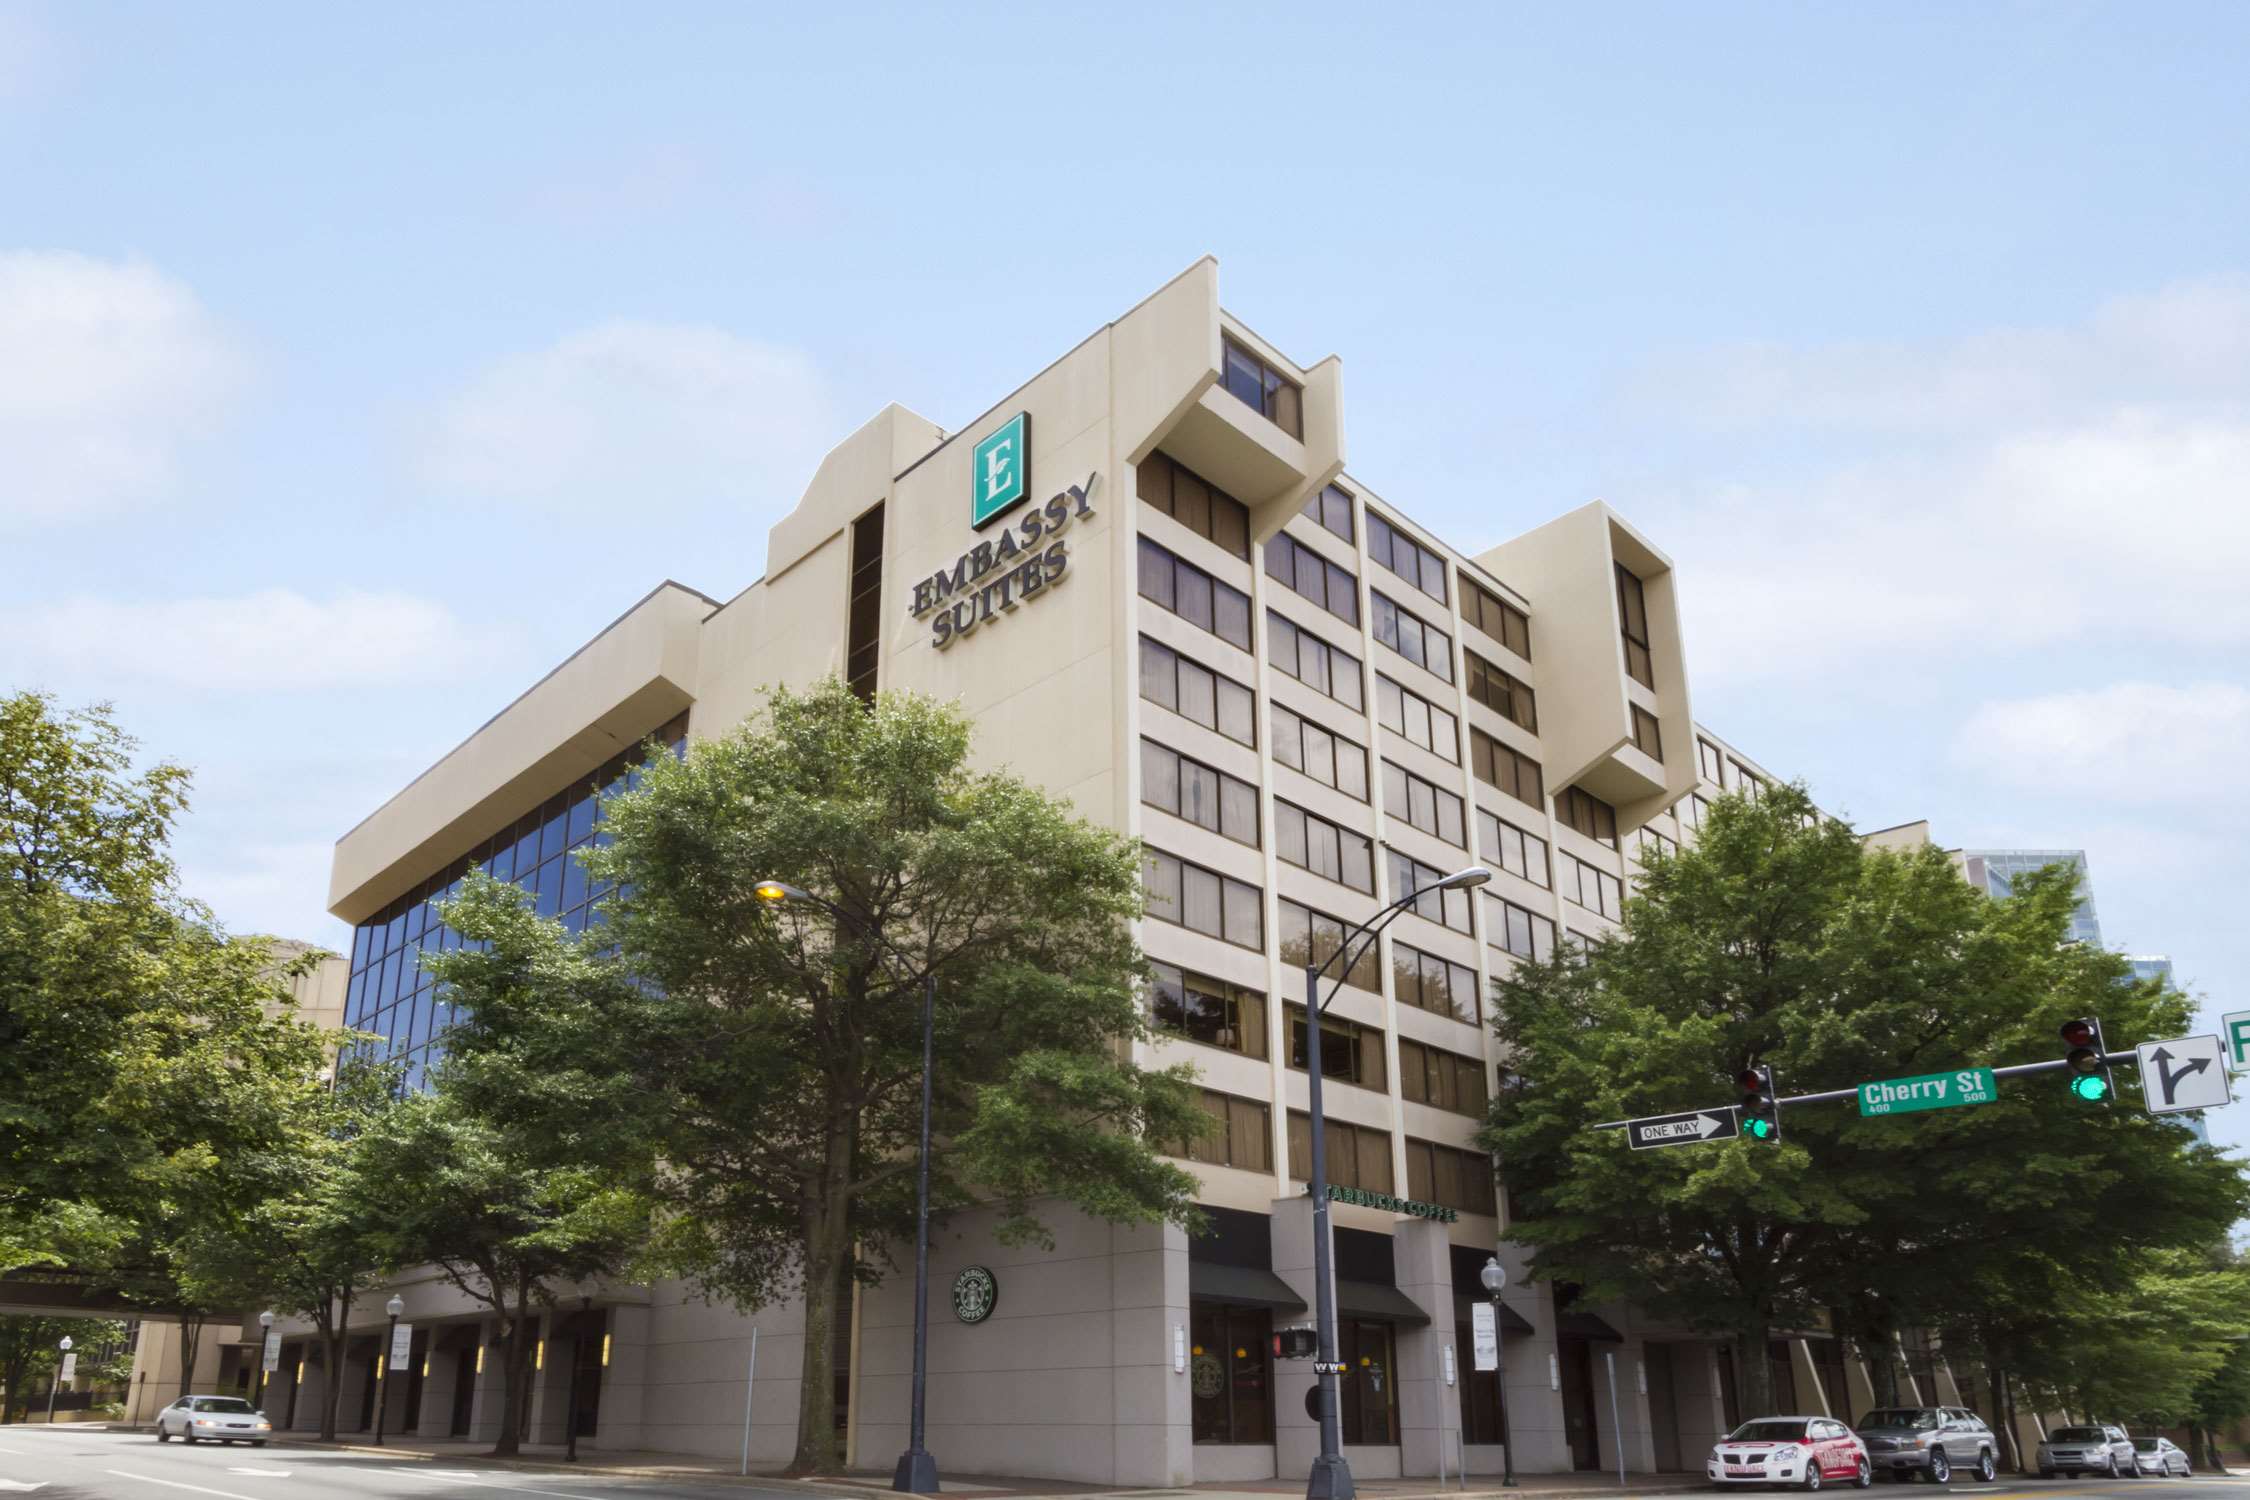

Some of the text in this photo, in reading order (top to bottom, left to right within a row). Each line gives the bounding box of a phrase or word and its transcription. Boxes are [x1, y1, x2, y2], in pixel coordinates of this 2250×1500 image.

[984, 438, 1012, 501] E
[911, 470, 1098, 619] EMBASSY
[932, 540, 1069, 650] SUITES
[1864, 1071, 1985, 1105] Cherry St
[1869, 1091, 1987, 1113] 400 500
[1643, 1121, 1700, 1139] ONE WAY
[1407, 1200, 1459, 1223] COFFEE
[958, 1304, 986, 1320] COFFEE
